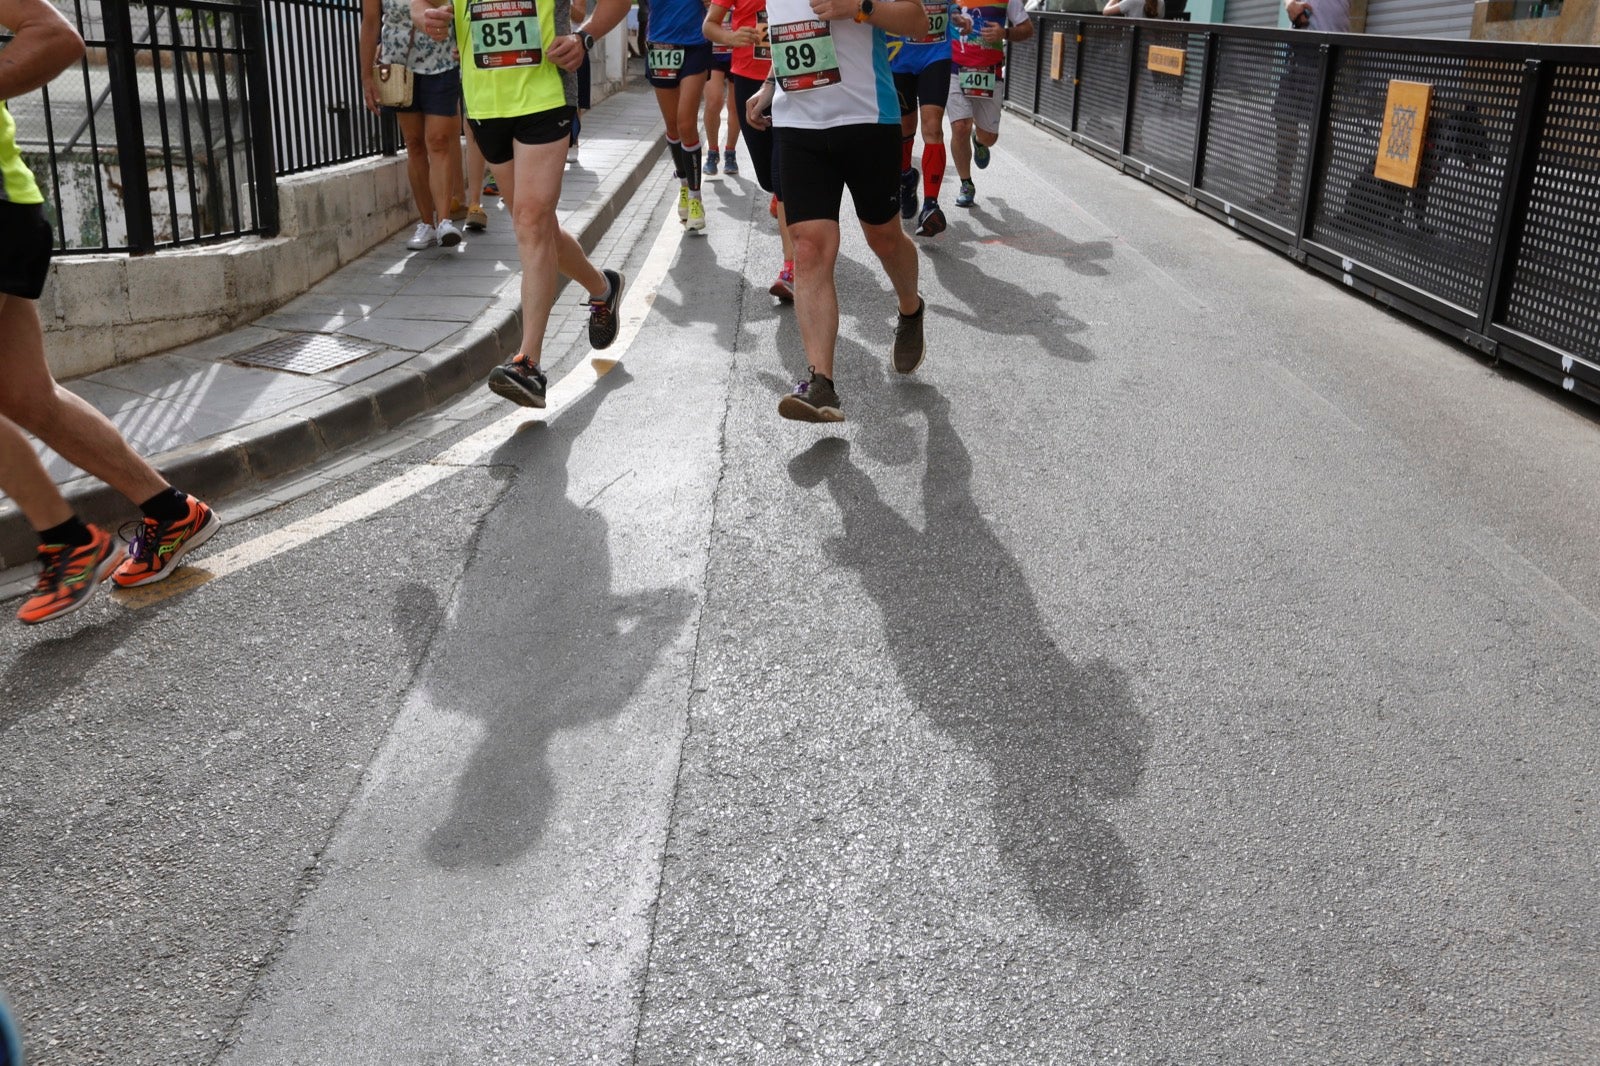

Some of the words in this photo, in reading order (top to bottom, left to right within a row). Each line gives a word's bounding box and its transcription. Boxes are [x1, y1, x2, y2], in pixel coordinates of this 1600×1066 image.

[482, 20, 529, 48] 851
[650, 51, 682, 66] 1119
[785, 43, 816, 70] 89
[965, 73, 989, 87] 401
